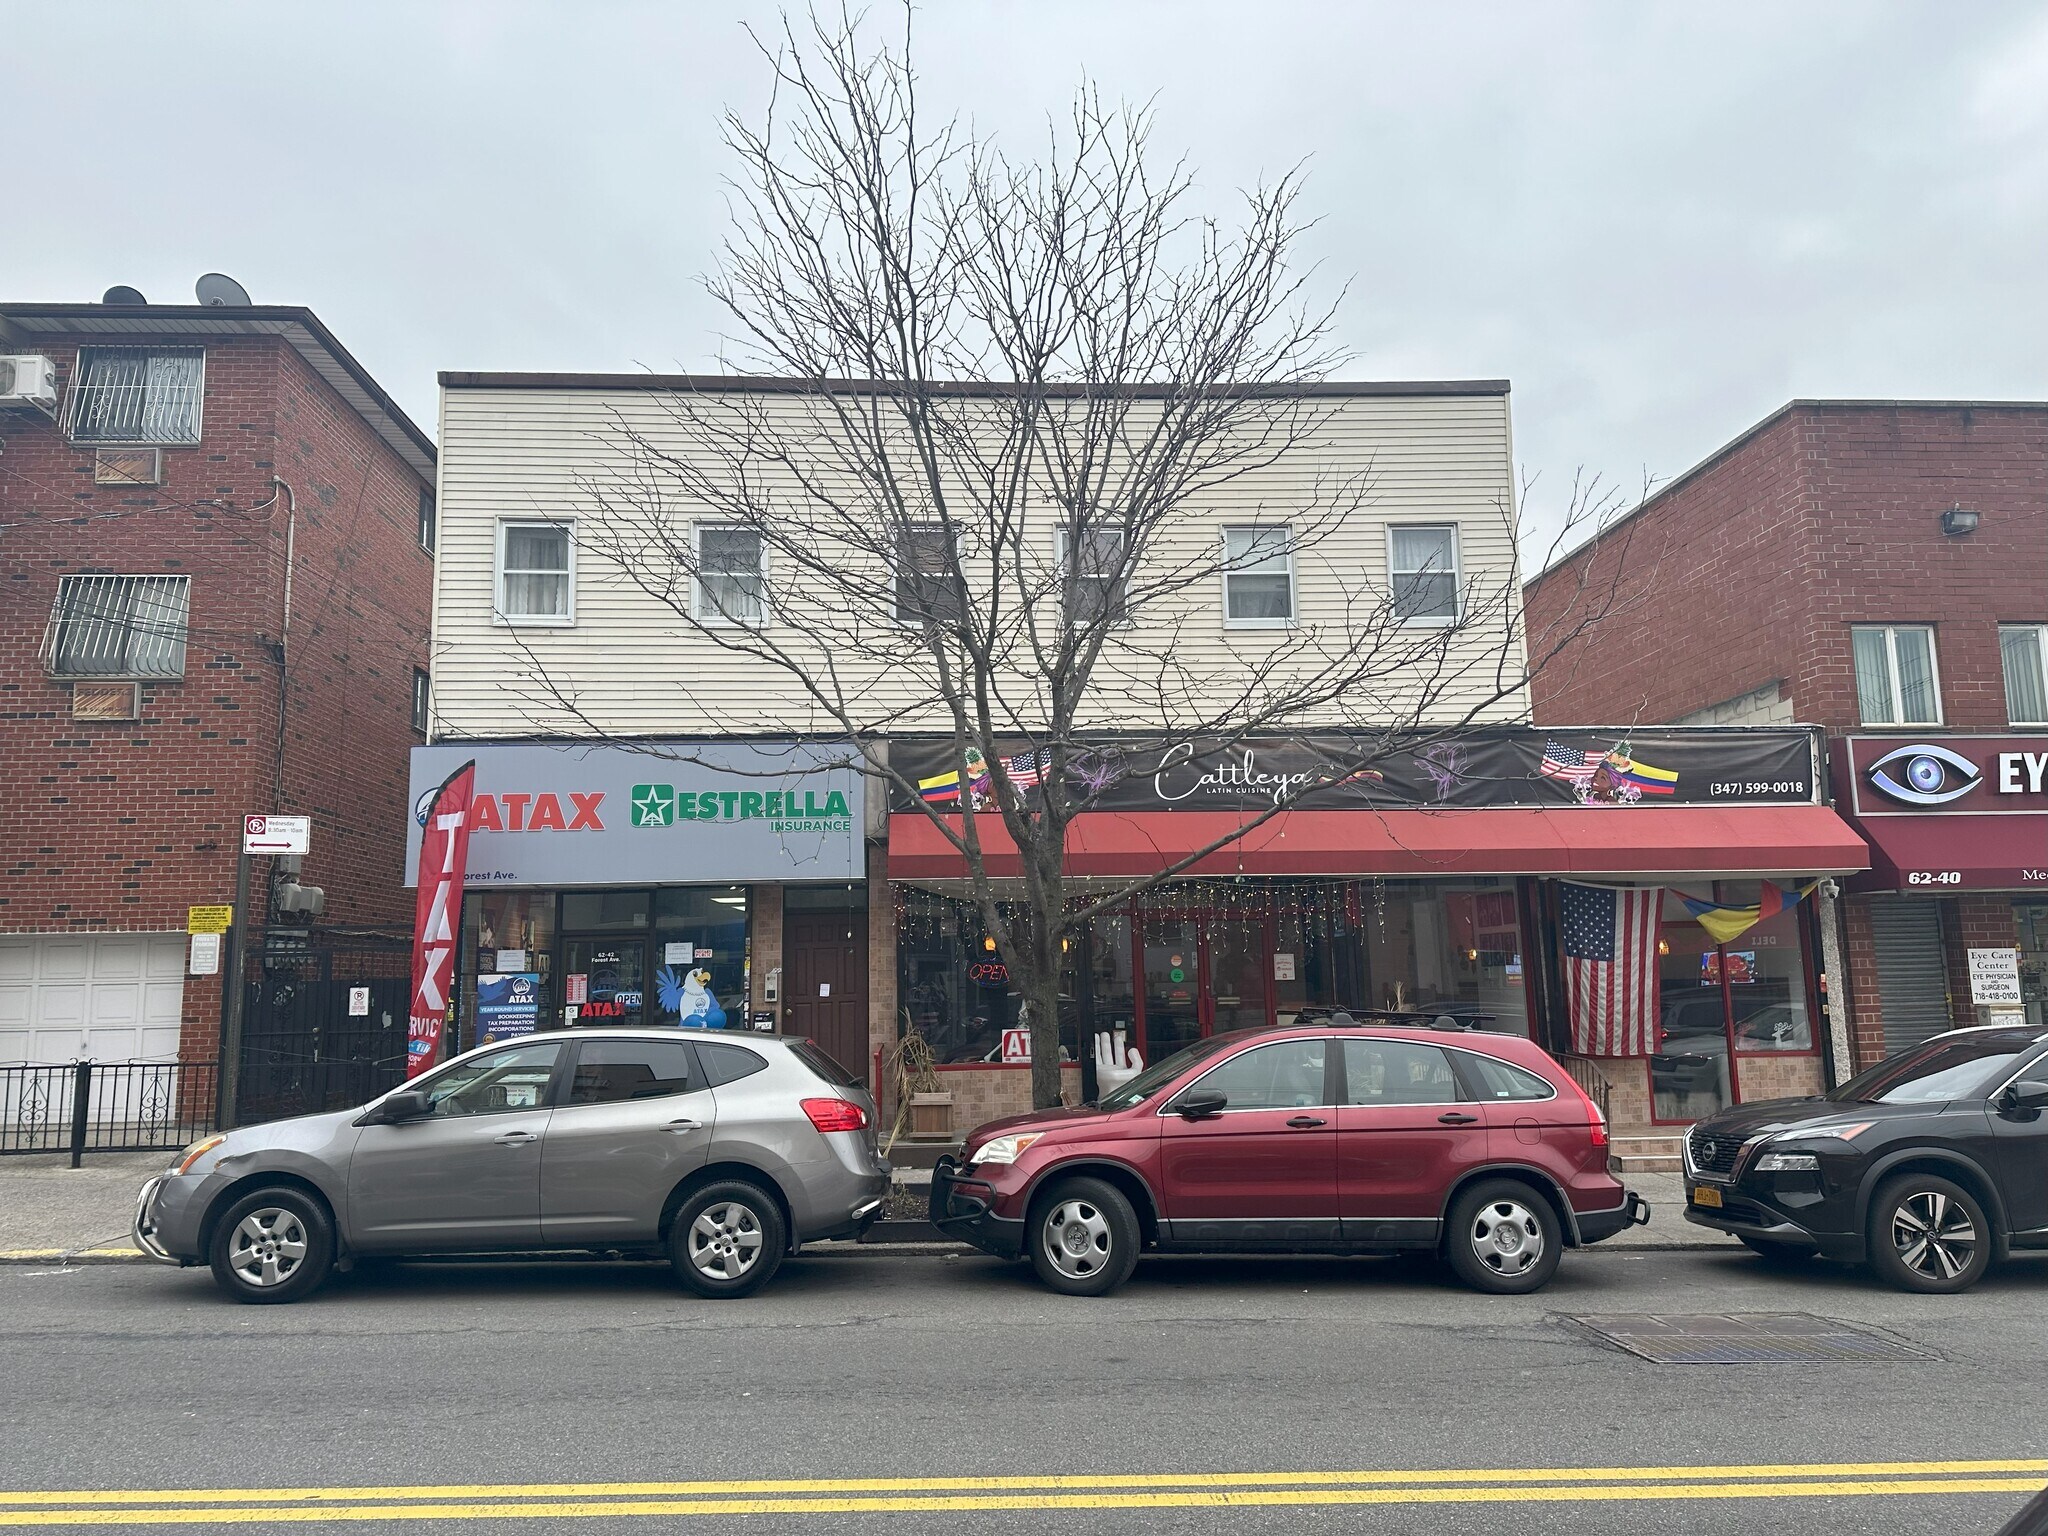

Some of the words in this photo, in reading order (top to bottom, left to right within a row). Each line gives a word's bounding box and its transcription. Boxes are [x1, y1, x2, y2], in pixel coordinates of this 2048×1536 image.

[1154, 742, 1313, 805] Cattleya
[1999, 752, 2048, 793] EY
[1710, 782, 1743, 796] (347)
[1745, 781, 1804, 794] 599-0018
[678, 790, 851, 820] ESTRELLA
[469, 792, 606, 832] ATAX
[770, 820, 851, 832] INSURANCE
[463, 871, 491, 880] orest
[493, 871, 518, 880] Ave.
[1908, 872, 1962, 885] 62-40
[1971, 951, 1988, 961] Eye
[1991, 951, 2014, 960] Care
[1976, 961, 2009, 970] Center
[508, 995, 534, 1004] ATAX
[617, 994, 642, 1004] OPEN
[1974, 992, 2019, 1000] 718-418-0100
[580, 1003, 626, 1017] ATAX
[408, 1015, 442, 1037] RVIC
[1005, 1031, 1031, 1057] AT
